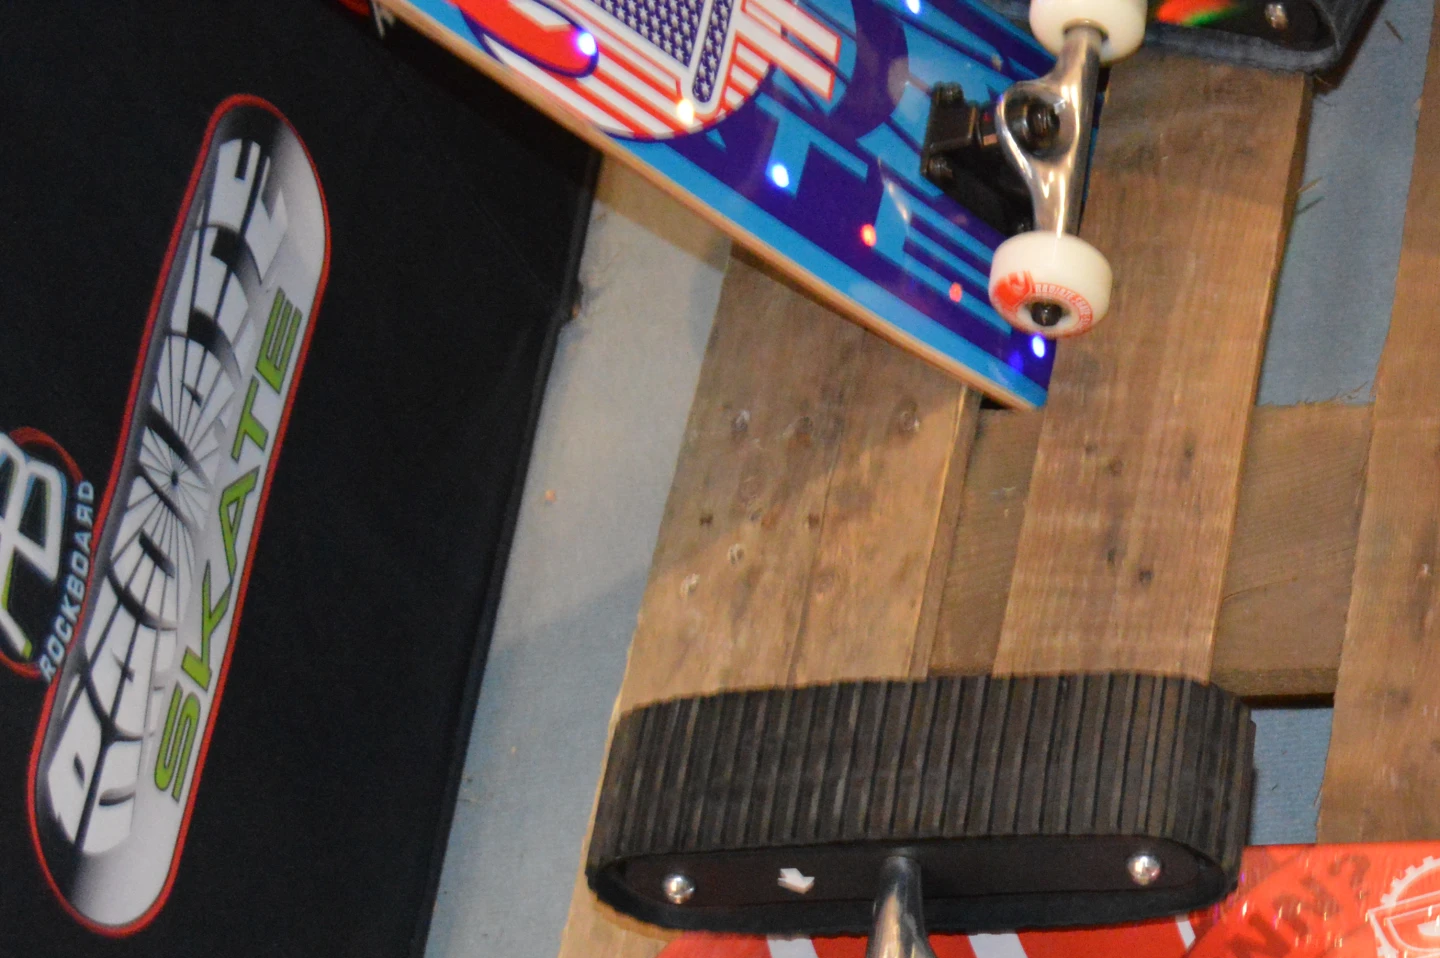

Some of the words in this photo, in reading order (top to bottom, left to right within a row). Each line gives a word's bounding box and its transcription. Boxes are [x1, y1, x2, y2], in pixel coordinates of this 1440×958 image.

[38, 480, 95, 682] ROCKBOARD
[47, 137, 288, 854] RADIATE
[154, 287, 302, 802] SKATE
